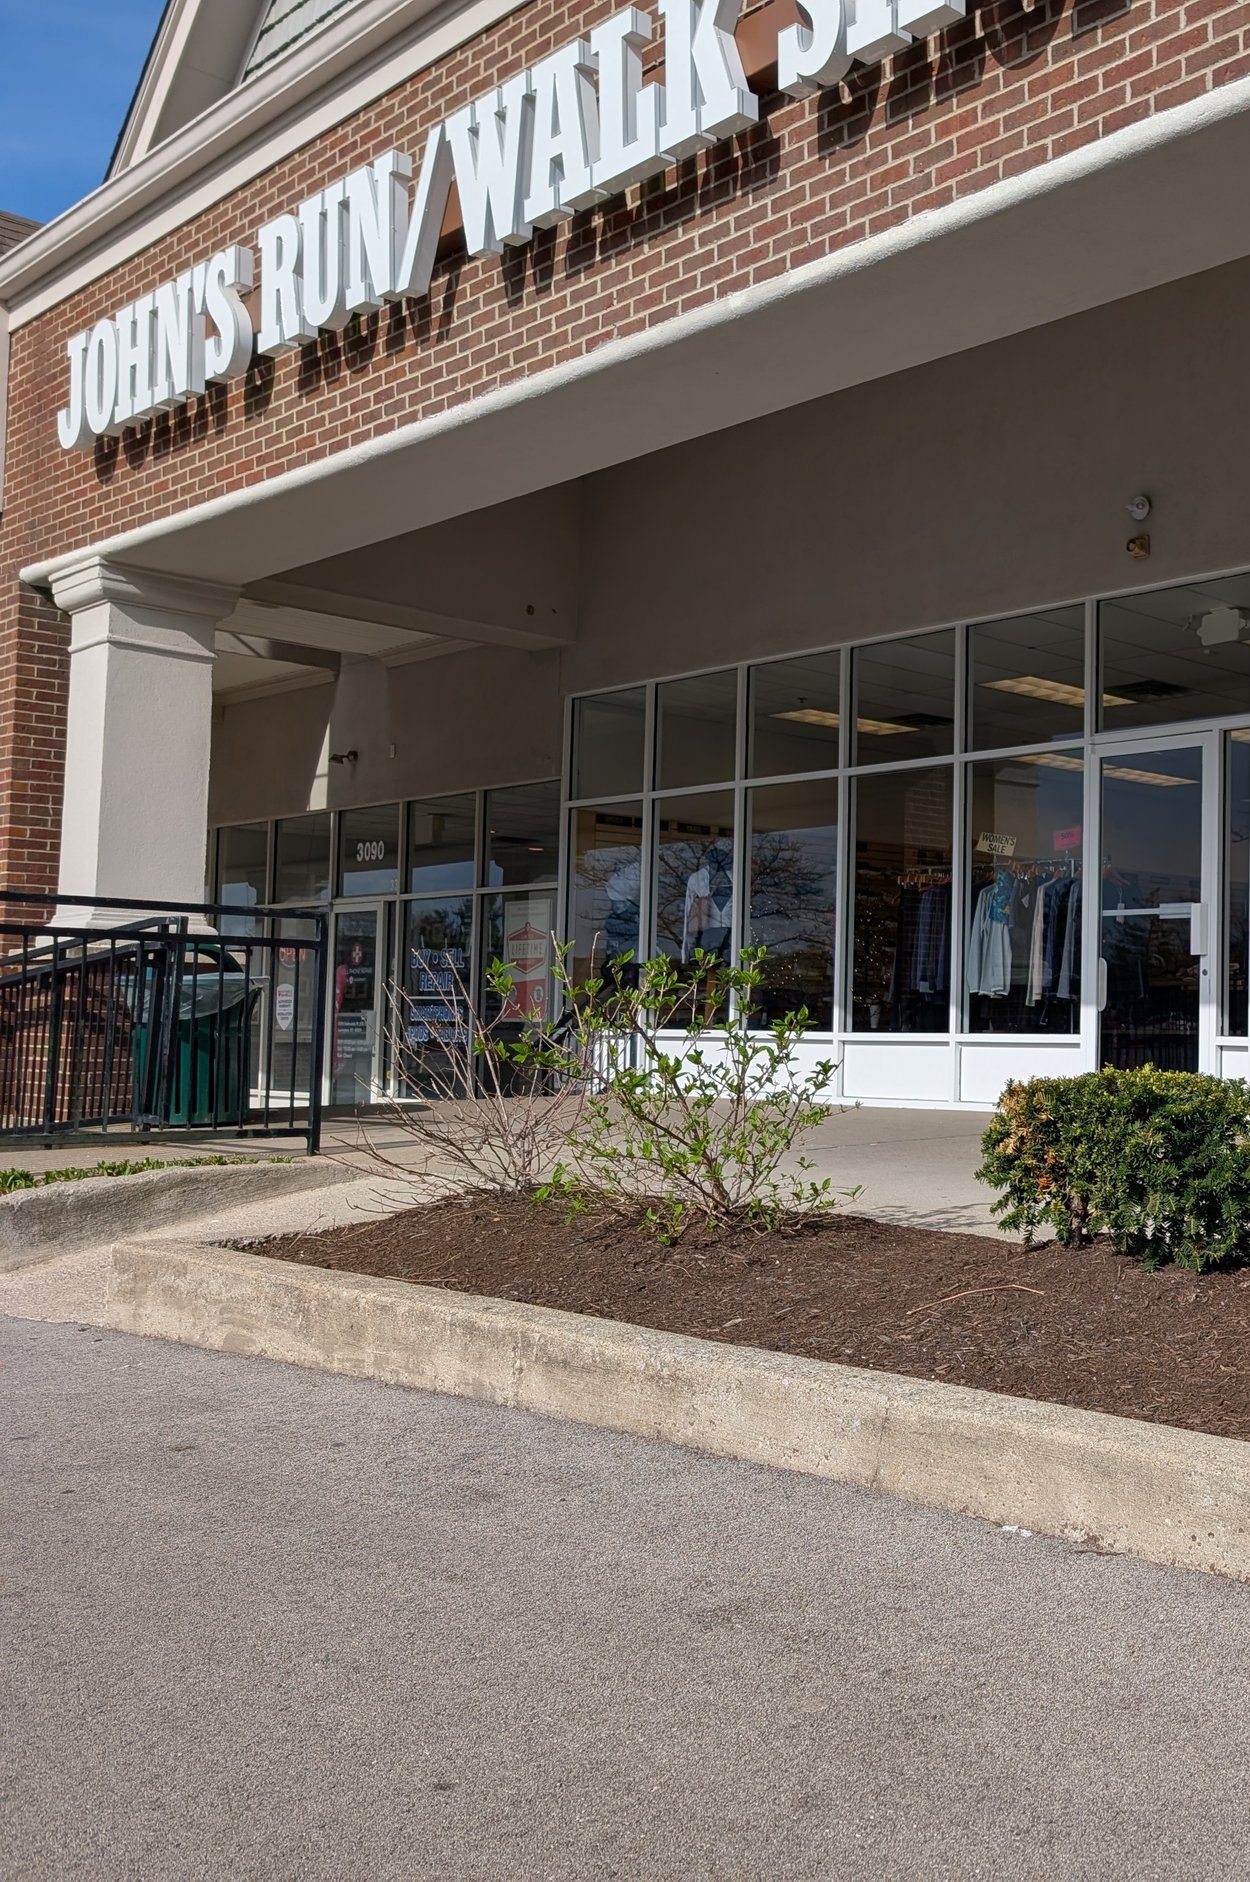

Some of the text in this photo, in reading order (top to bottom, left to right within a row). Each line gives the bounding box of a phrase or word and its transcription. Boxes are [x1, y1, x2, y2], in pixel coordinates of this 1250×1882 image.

[57, 245, 250, 450] JOHN'S
[982, 832, 1016, 846] WOMEN'S
[987, 843, 1006, 854] SALE
[356, 840, 385, 862] 3090
[410, 947, 465, 969] BUY SELL
[419, 971, 455, 991] REPAIR
